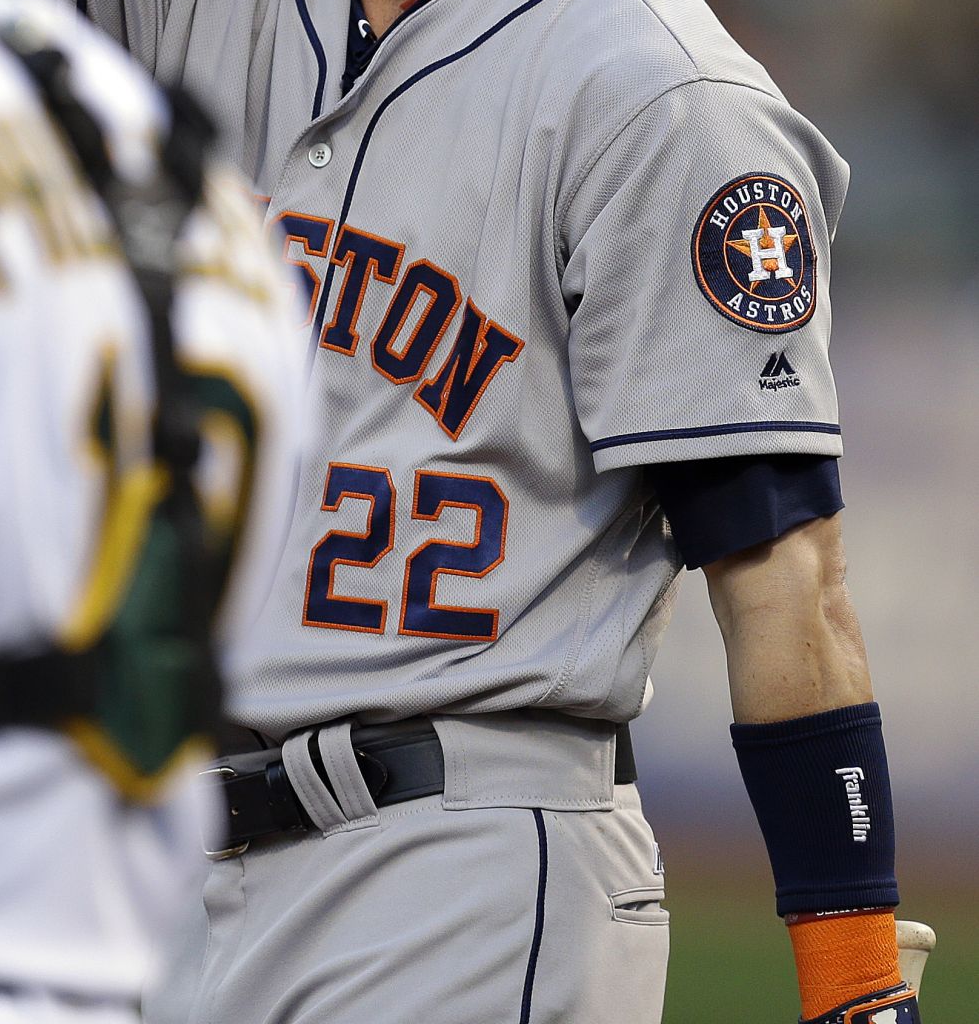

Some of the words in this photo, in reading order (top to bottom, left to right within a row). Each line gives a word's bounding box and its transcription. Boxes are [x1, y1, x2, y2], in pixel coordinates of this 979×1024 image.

[710, 182, 803, 230] HOUSTON
[741, 226, 794, 282] H
[258, 204, 525, 442] STON
[726, 284, 812, 322] ASTROS
[759, 376, 800, 392] Majestic
[301, 461, 510, 642] 22
[834, 766, 871, 843] Franklin
